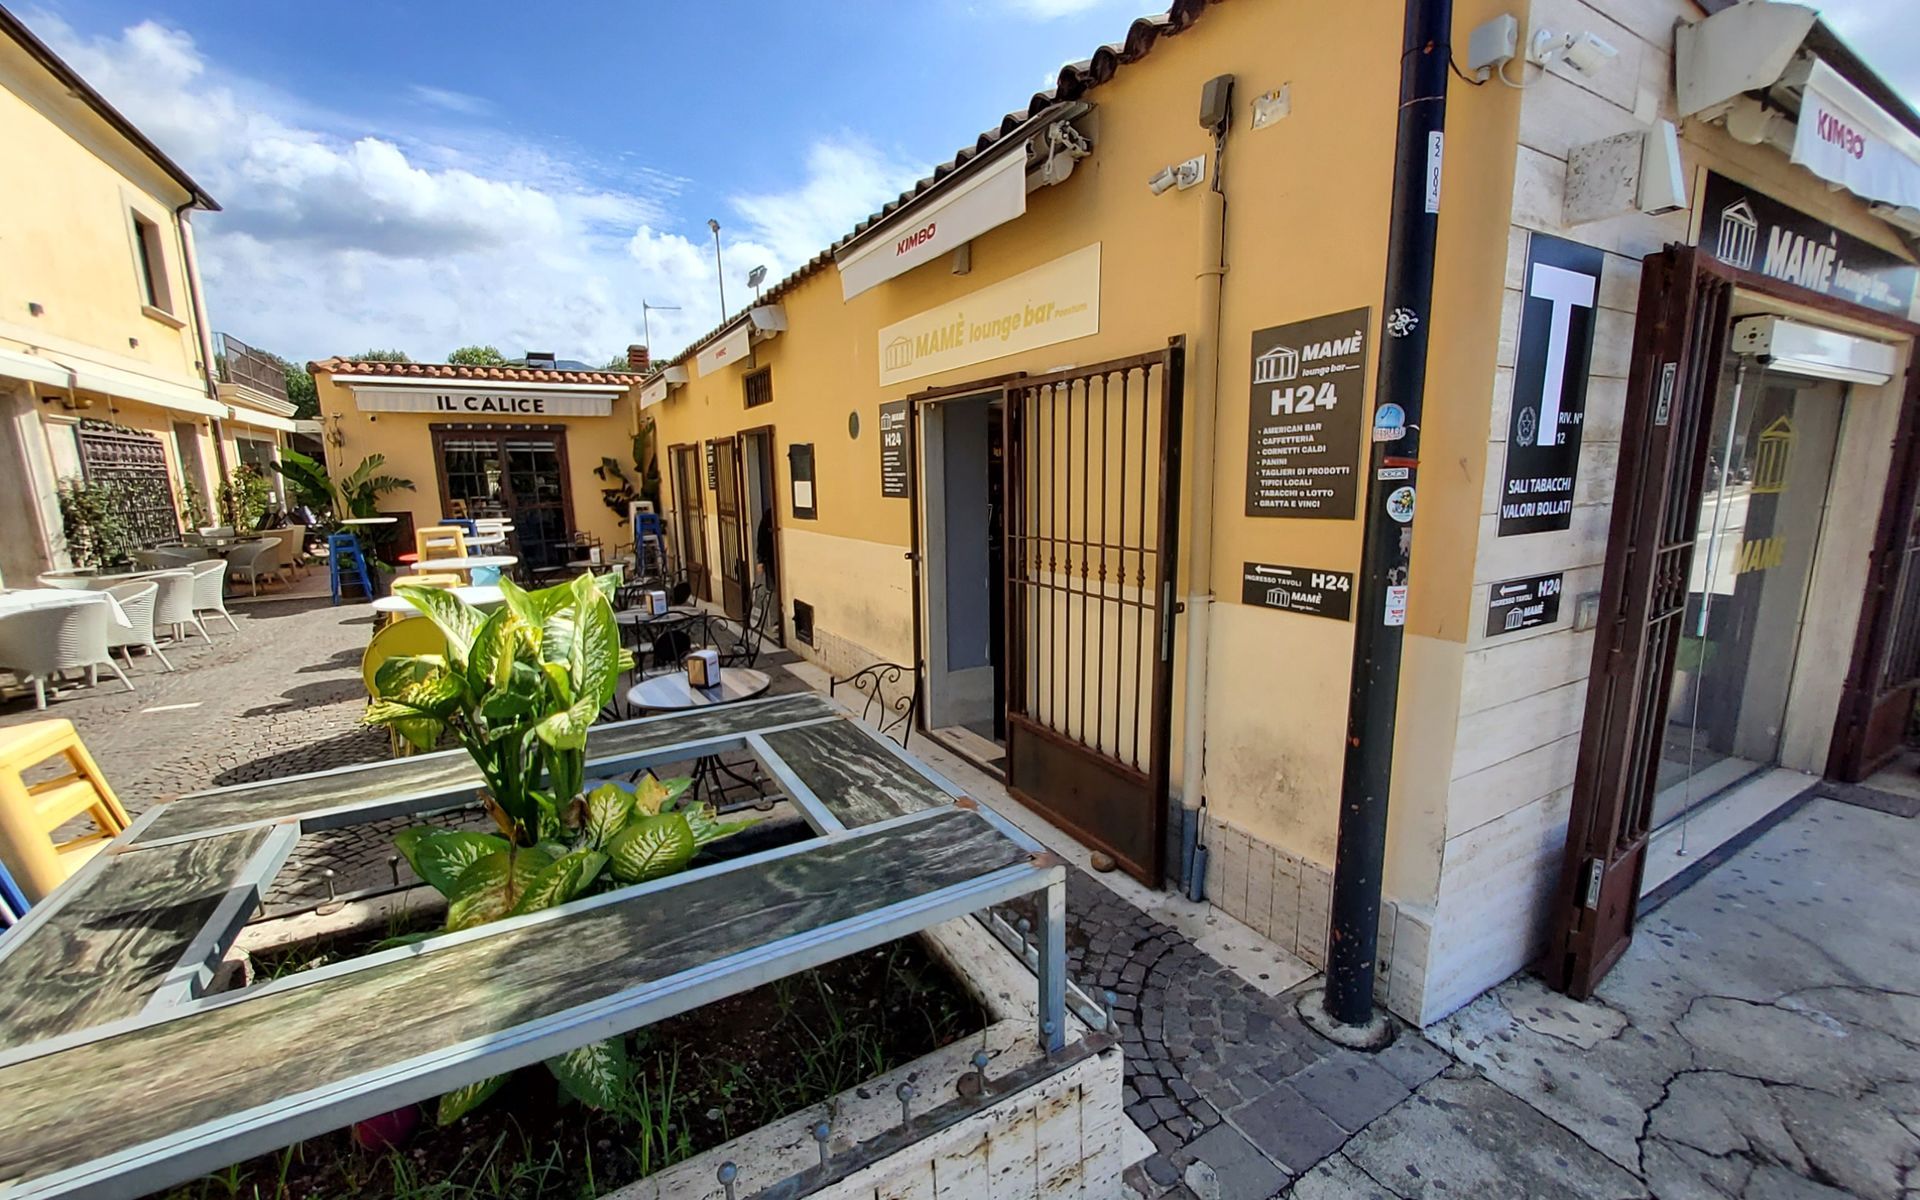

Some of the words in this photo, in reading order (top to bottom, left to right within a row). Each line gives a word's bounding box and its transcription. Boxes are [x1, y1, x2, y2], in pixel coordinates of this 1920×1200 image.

[1817, 109, 1864, 159] KIMBO
[896, 222, 936, 257] KIMBO
[1763, 226, 1836, 292] MAMÈ
[915, 312, 965, 359] MAMÈ
[969, 316, 1021, 343] lounge
[1023, 301, 1055, 328] bar
[1302, 329, 1362, 362] MAMÈ
[1530, 262, 1596, 446] T
[1302, 366, 1329, 377] lounge
[1331, 364, 1346, 373] bar
[437, 395, 457, 411] IL
[464, 396, 544, 413] CALICE
[1271, 381, 1337, 416] H24
[1558, 411, 1572, 424] RIV.
[1263, 424, 1303, 435] AMERICAN
[1305, 422, 1322, 431] BAR
[885, 432, 902, 447] H24
[1262, 434, 1314, 445] CAFFETTERIA
[1557, 432, 1566, 444] 12
[1262, 446, 1300, 456] CORNETTI
[1302, 444, 1326, 454] CALDI
[1261, 458, 1287, 466] PANINI
[1261, 468, 1295, 477] TAGLIERI
[1297, 468, 1305, 476] DI
[1307, 467, 1350, 476] PRODOTTI
[1284, 478, 1312, 487] LOCALI
[1508, 479, 1528, 495] SALI
[1530, 477, 1571, 493] TABACCHI
[1260, 490, 1298, 498] TABACCHI
[1306, 489, 1334, 498] LOTTO
[1259, 500, 1289, 509] GRATTA
[1291, 500, 1296, 508] E
[1298, 500, 1320, 508] VINCI
[1503, 503, 1536, 519] VALORI
[1536, 500, 1571, 516] BOLLATI
[1244, 574, 1277, 584] INGRESSO
[1277, 578, 1302, 587] TAVOLI
[1311, 573, 1350, 592] H24
[1538, 578, 1561, 598] H24
[1291, 592, 1322, 604] MAMÈ
